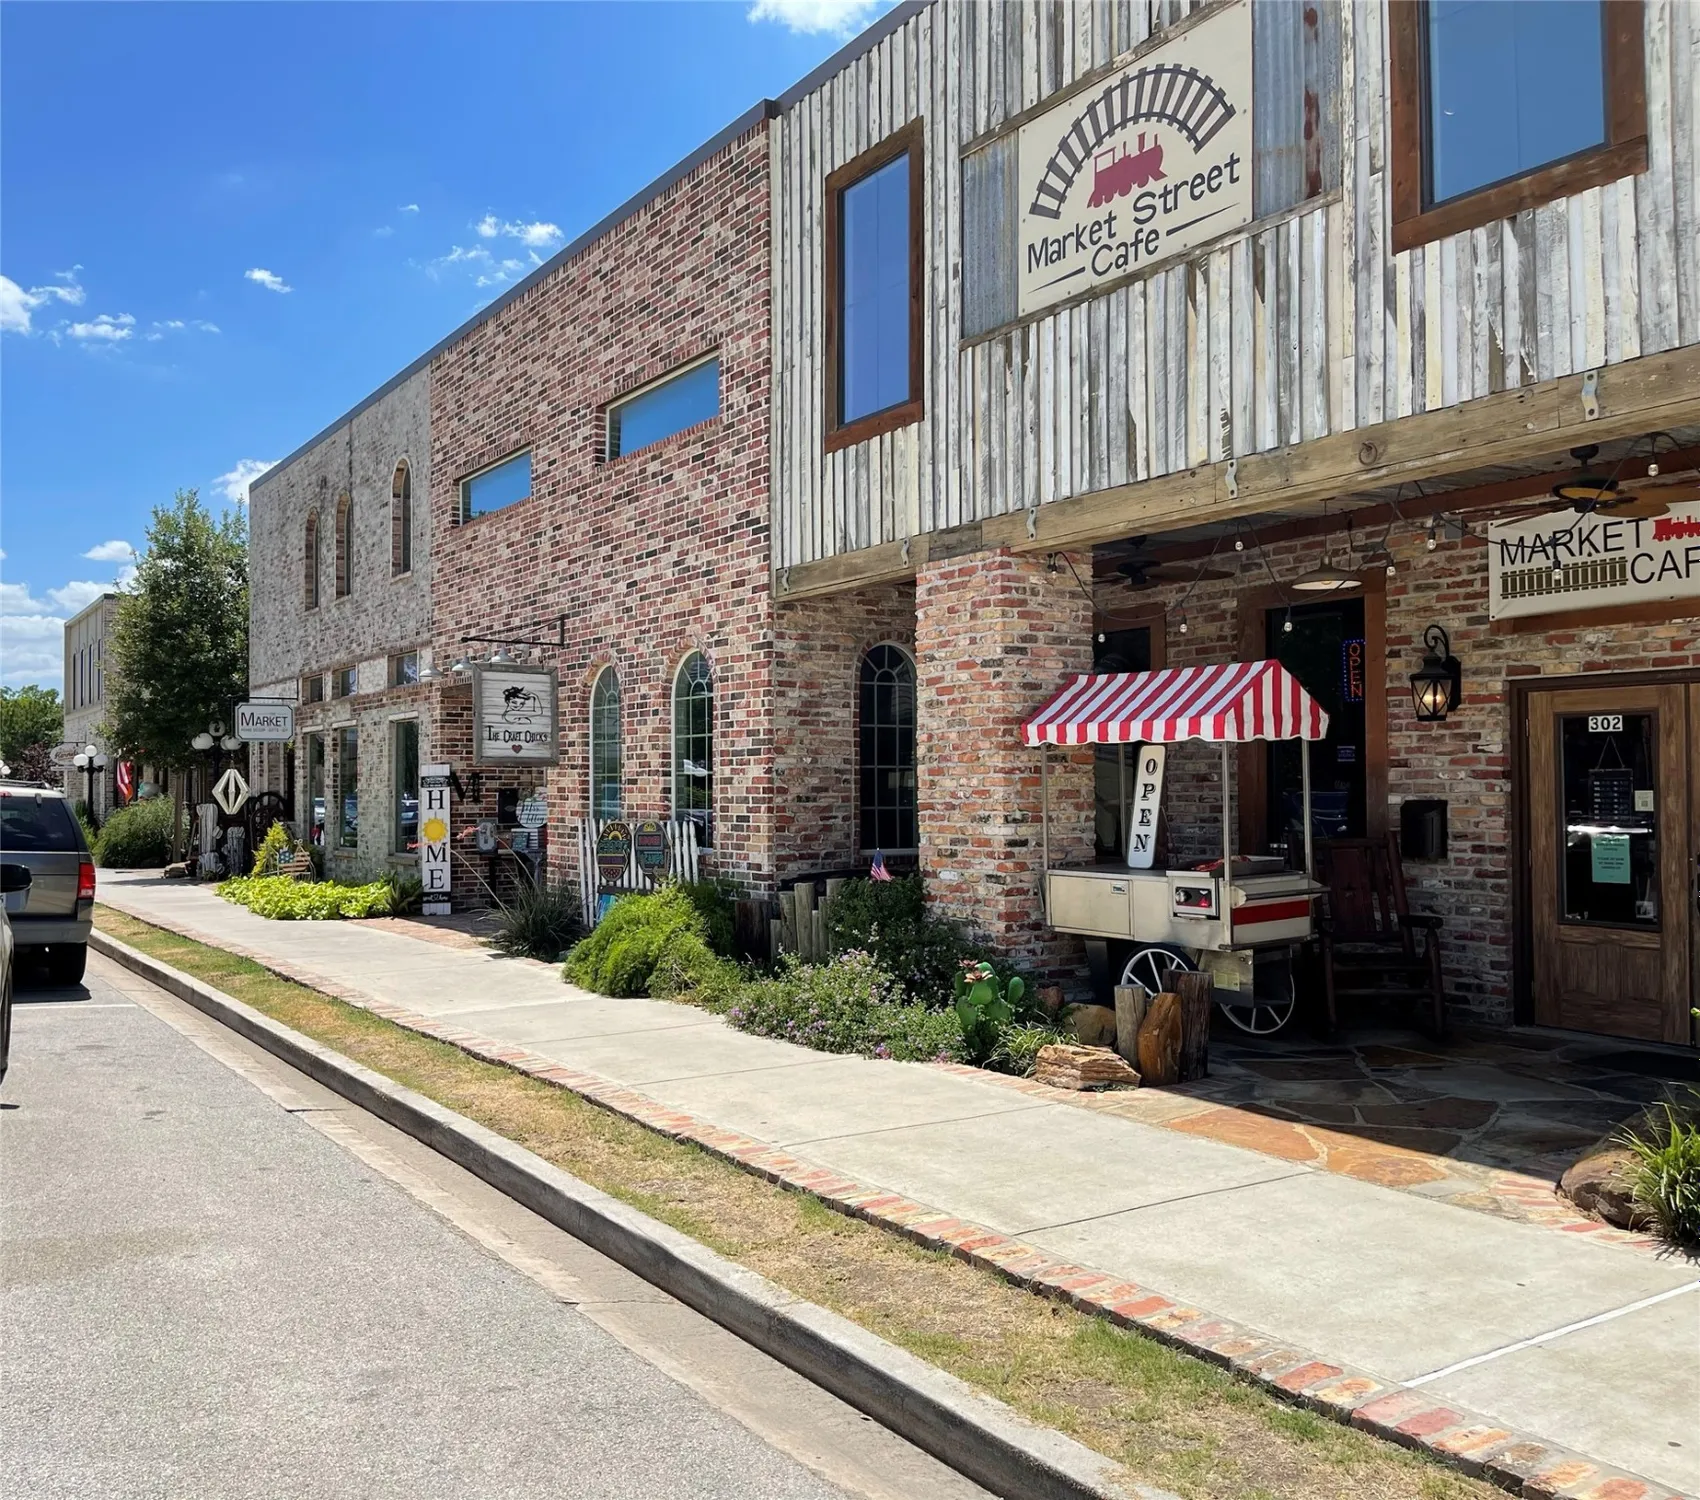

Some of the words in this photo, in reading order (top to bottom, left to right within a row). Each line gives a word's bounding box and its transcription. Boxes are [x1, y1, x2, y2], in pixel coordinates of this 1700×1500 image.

[1027, 210, 1117, 274] Market
[1132, 151, 1241, 225] Street
[1091, 227, 1160, 277] Cafe
[1500, 517, 1649, 567] MARKET
[1349, 643, 1362, 698] OPEN
[240, 712, 288, 727] MARKET
[1590, 716, 1622, 731] 302
[1133, 758, 1158, 852] OPEN
